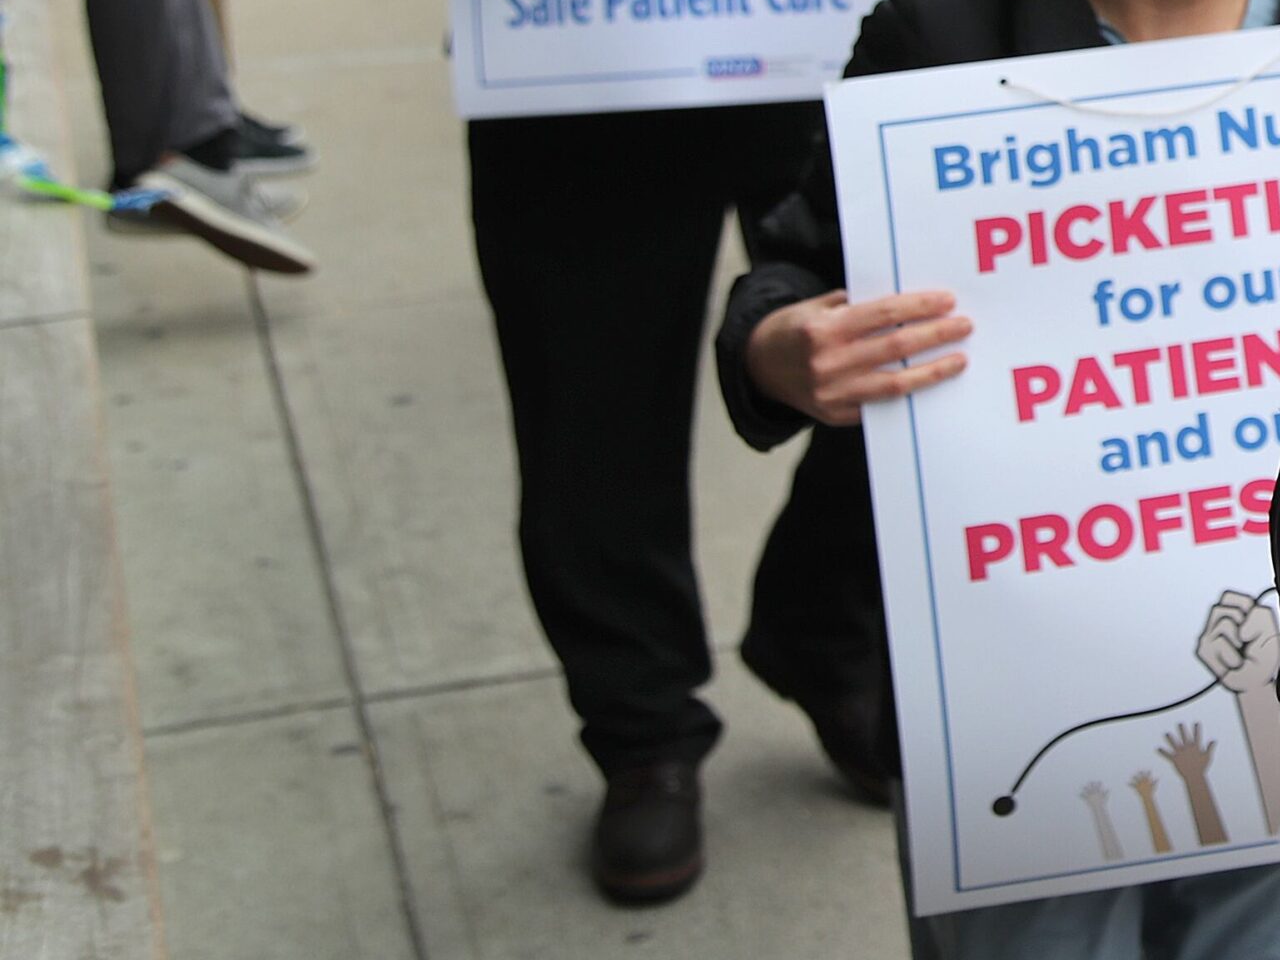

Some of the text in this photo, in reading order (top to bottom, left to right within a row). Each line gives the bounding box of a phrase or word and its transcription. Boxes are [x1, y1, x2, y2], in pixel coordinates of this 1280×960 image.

[934, 123, 1197, 191] Brigham
[1093, 278, 1180, 327] for
[1101, 411, 1211, 473] and
[964, 478, 1278, 583] PROFES
